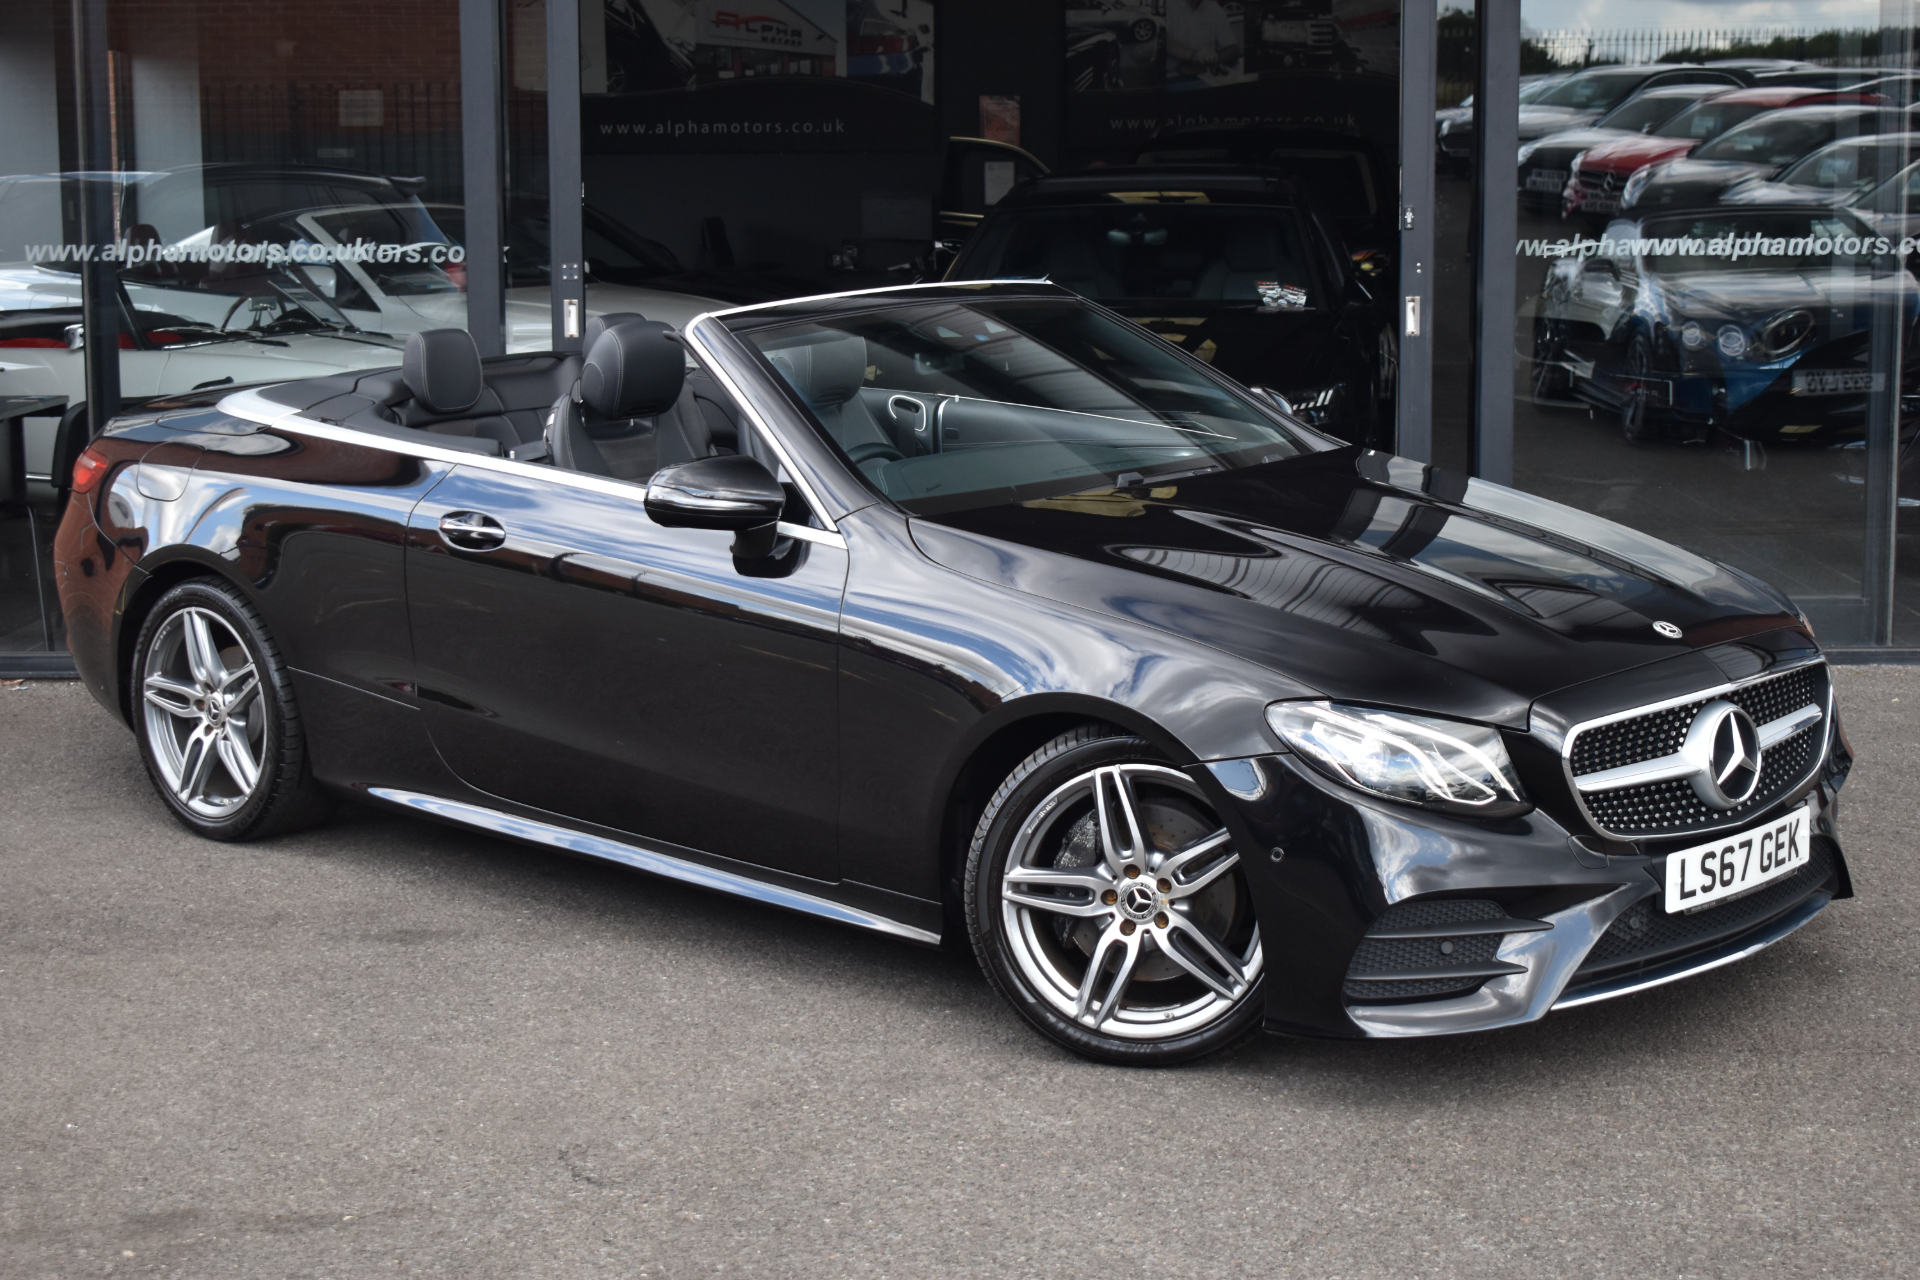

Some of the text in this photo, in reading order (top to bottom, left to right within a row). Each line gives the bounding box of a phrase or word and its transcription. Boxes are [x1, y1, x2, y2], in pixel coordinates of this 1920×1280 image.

[712, 10, 803, 38] ALPHA
[600, 119, 845, 137] www.alphamotors.co.uk
[1630, 232, 1920, 261] www.alphamotors.c
[1679, 818, 1800, 900] LS67 GEK
